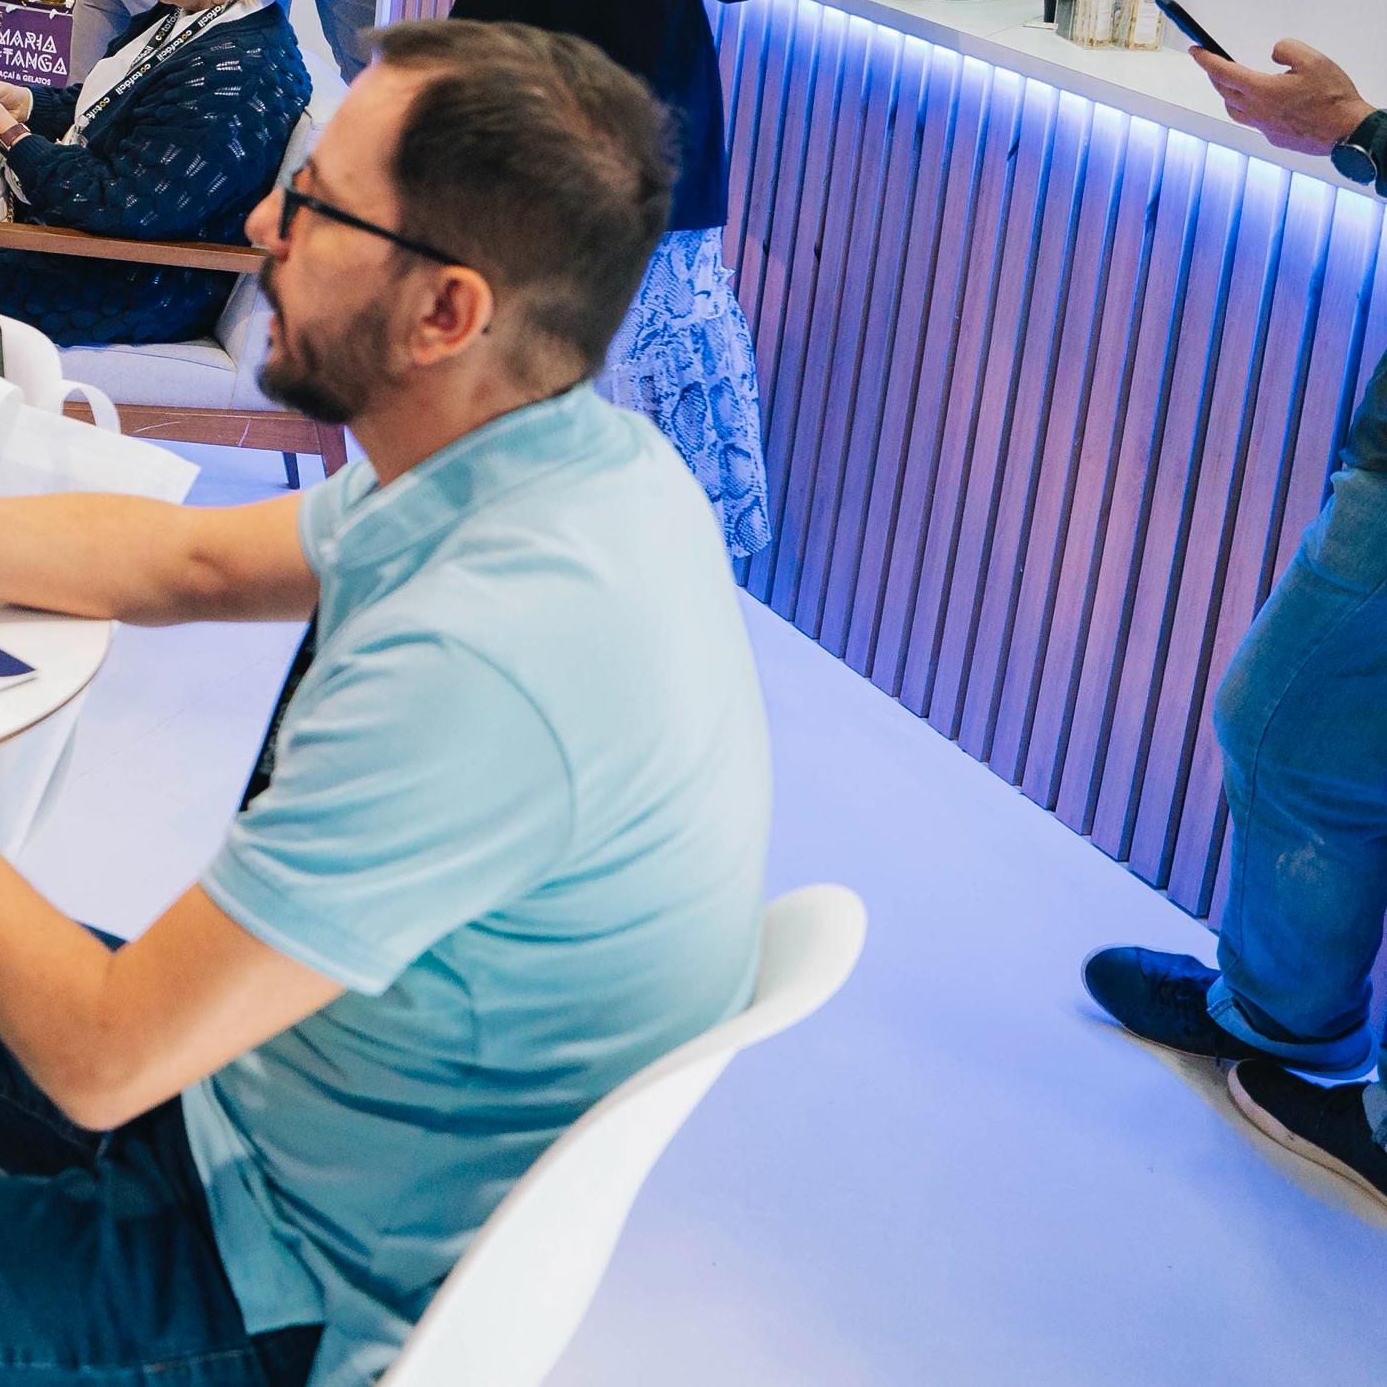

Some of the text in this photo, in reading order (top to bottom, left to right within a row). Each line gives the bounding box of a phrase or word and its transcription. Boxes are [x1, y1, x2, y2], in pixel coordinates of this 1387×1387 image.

[157, 30, 192, 62] cotafácil
[22, 74, 52, 86] GELATOS
[115, 63, 152, 95] cotafácil
